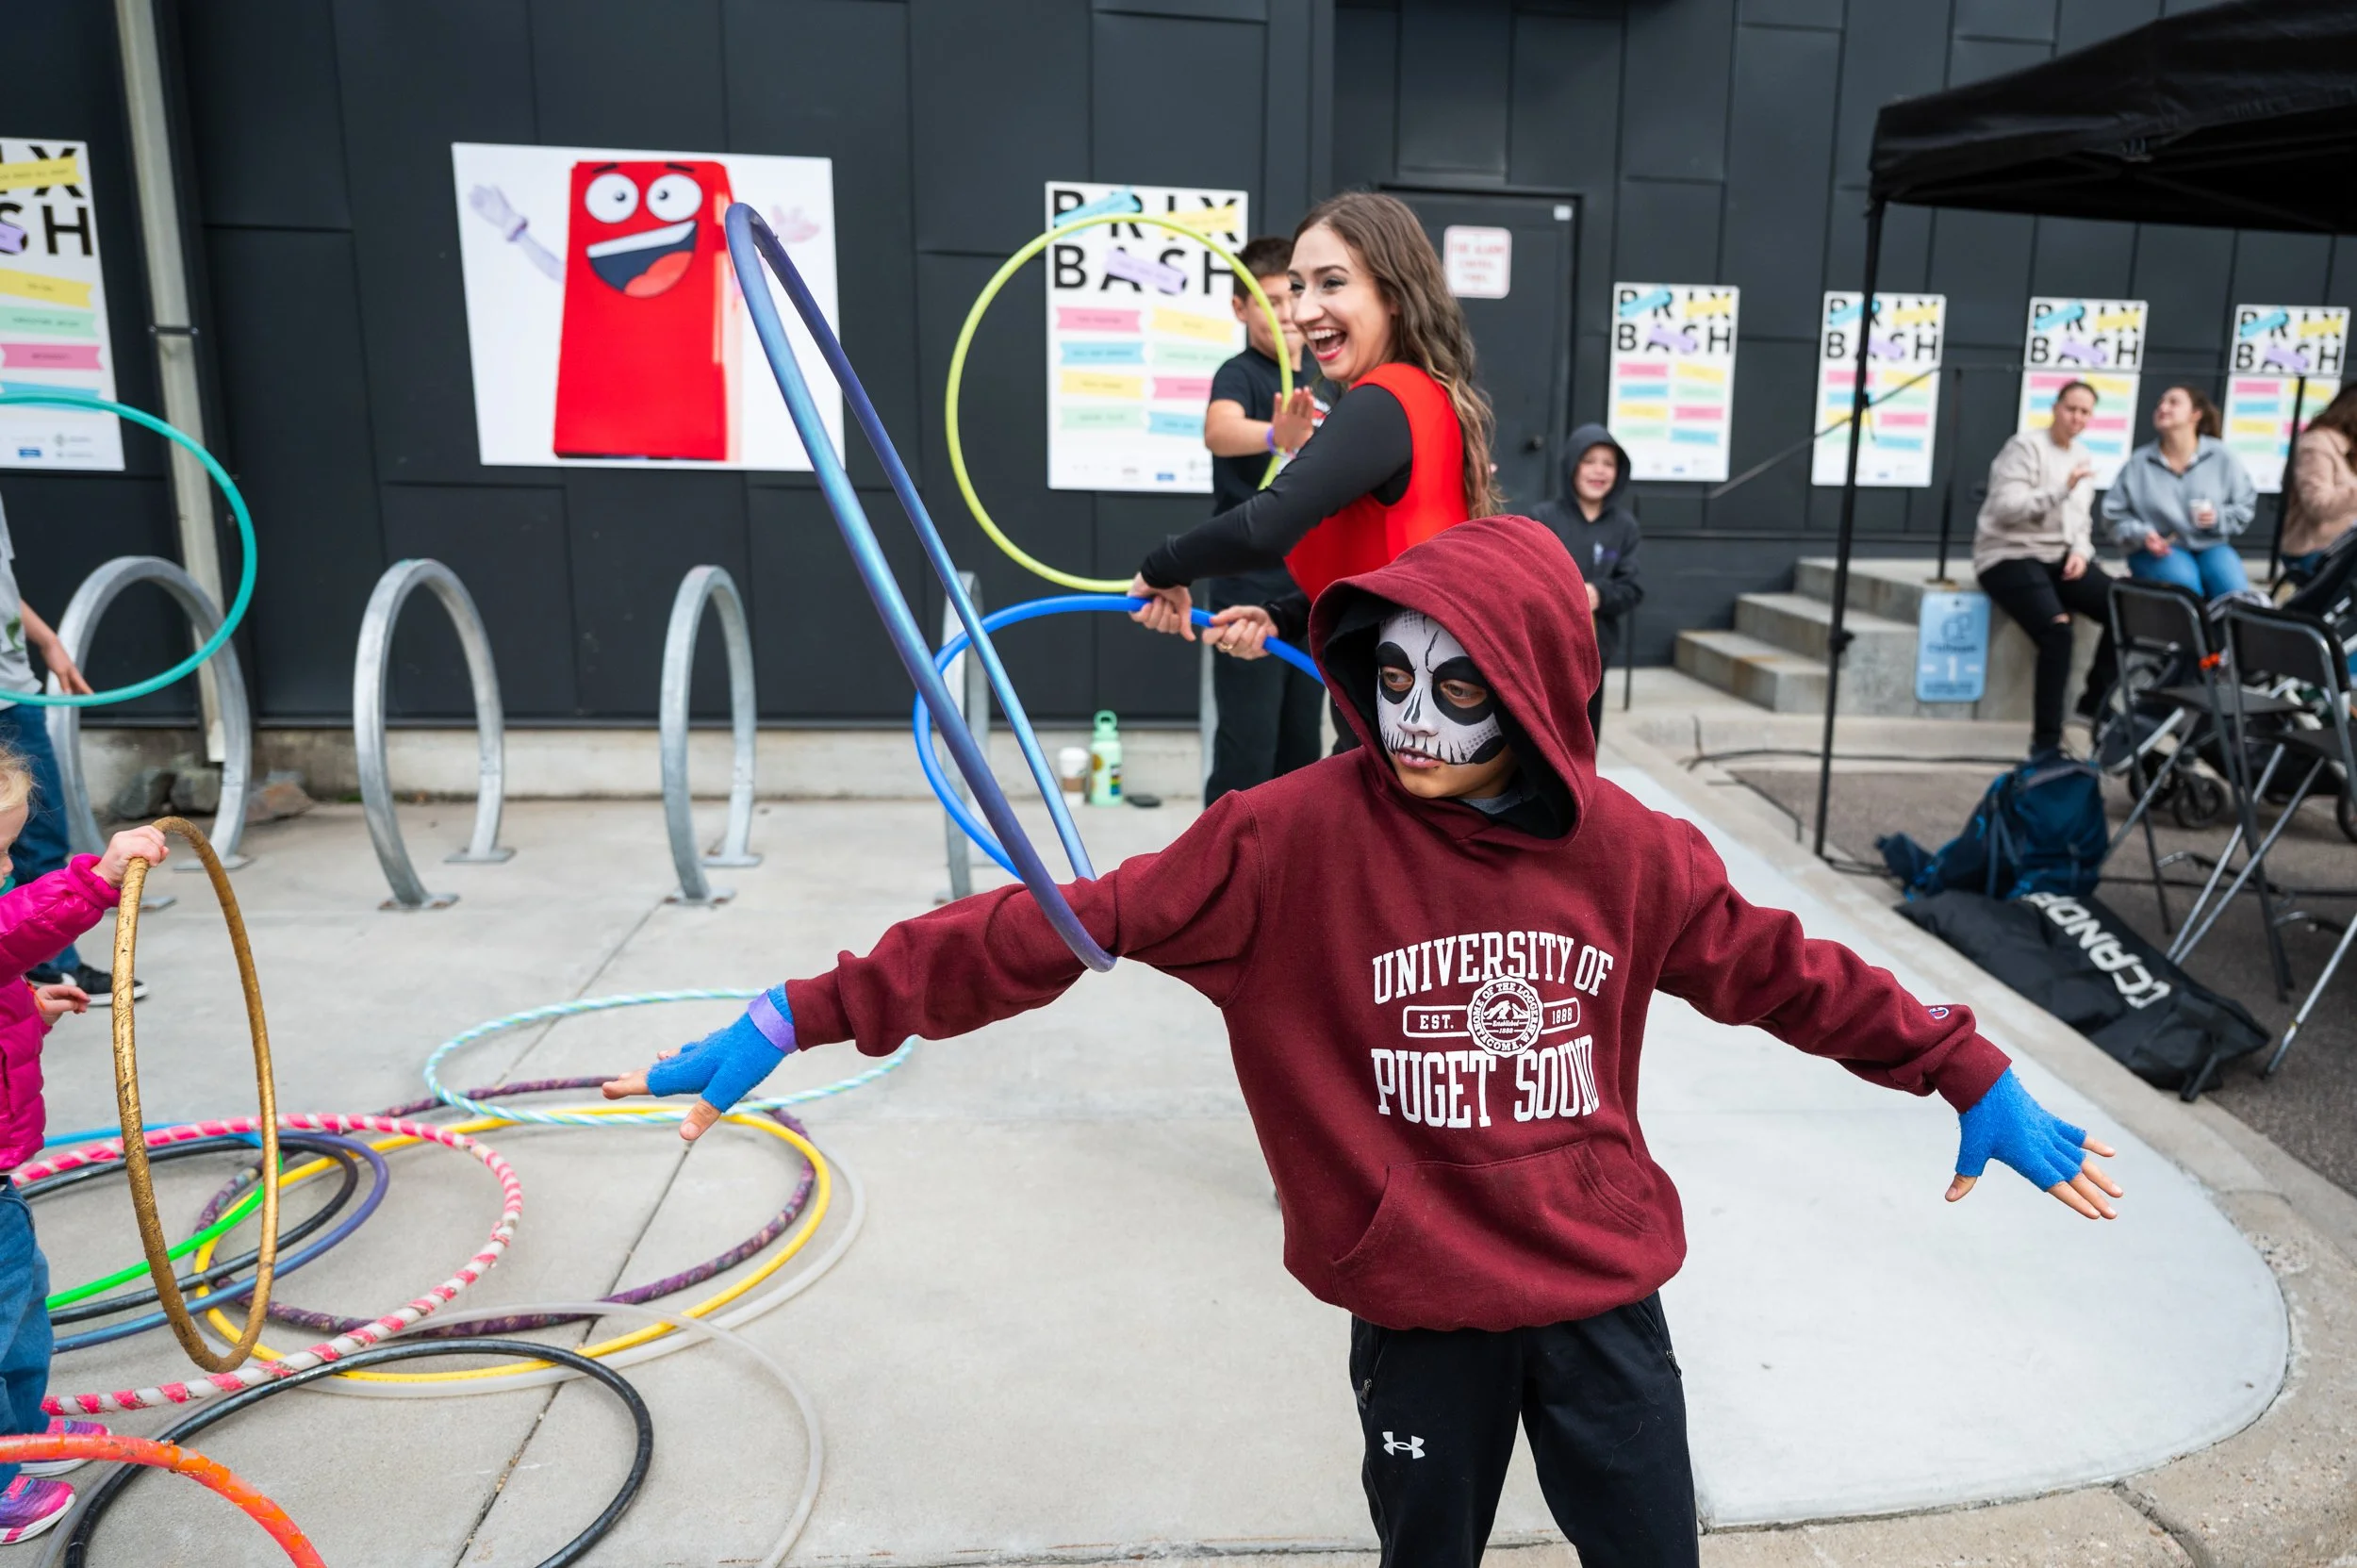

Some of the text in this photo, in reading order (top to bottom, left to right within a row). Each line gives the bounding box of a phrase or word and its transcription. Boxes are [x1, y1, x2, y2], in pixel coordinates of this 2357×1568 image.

[1373, 931, 1614, 1005] UNIVERSITY OF
[1419, 1014, 1455, 1030] EST.
[1473, 999, 1485, 1030] HOME
[1482, 986, 1494, 999] OF
[1496, 982, 1516, 992] THE
[1552, 1006, 1573, 1025] 1888
[1371, 1034, 1600, 1129] PUGET SOUND
